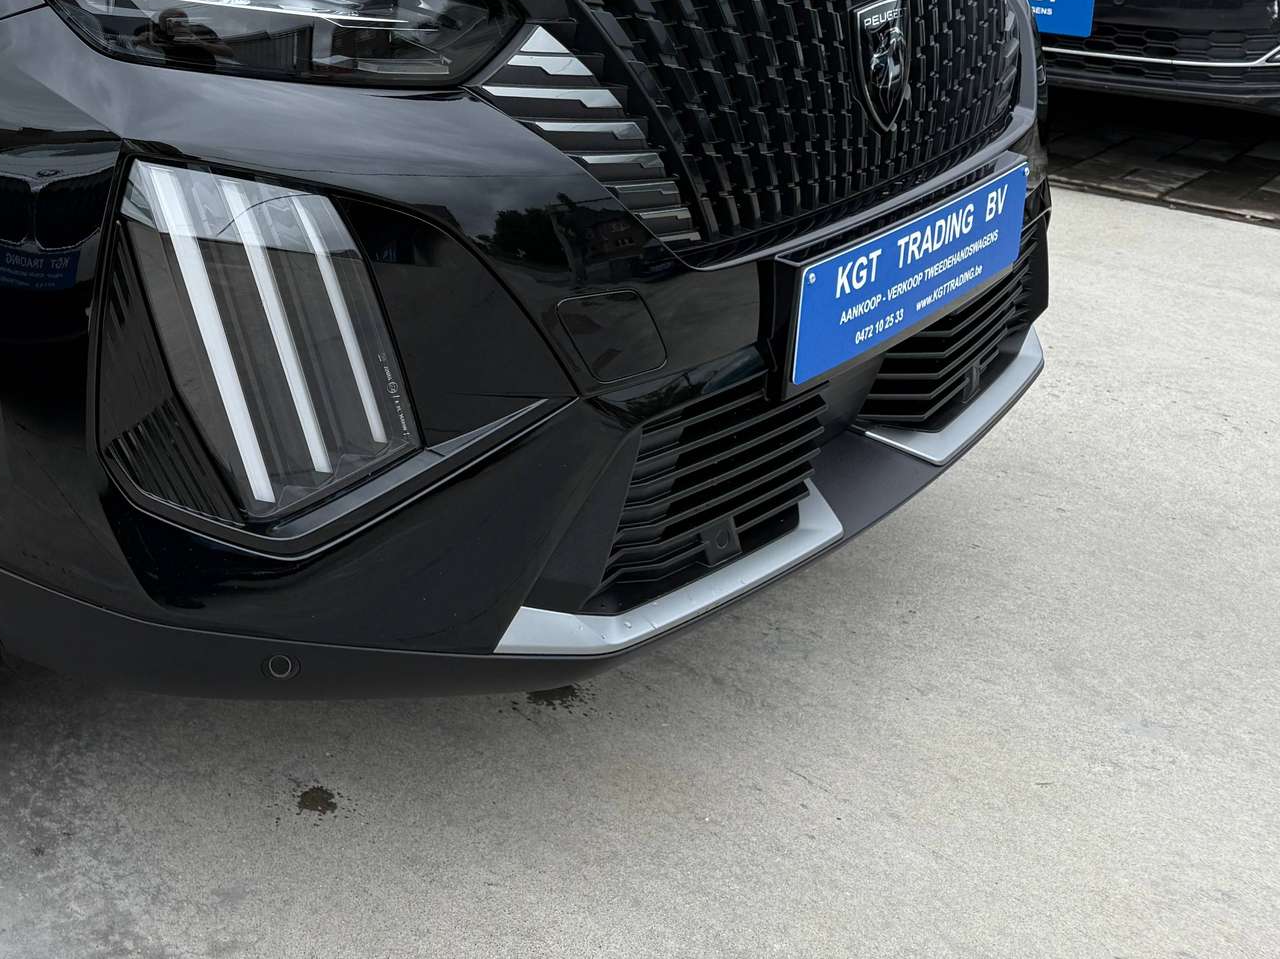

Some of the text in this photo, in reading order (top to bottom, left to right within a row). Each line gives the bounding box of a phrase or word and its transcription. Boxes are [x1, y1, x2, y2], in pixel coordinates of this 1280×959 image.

[835, 184, 1009, 299] KGT TRADING BV
[839, 294, 883, 325] AANKOOP
[887, 272, 924, 301] VERKOOP
[923, 229, 999, 280] TWEEDEHANDSWAGENS
[916, 264, 983, 312] www.KGTTRADING.be
[855, 308, 904, 344] 0472 10 25 33
